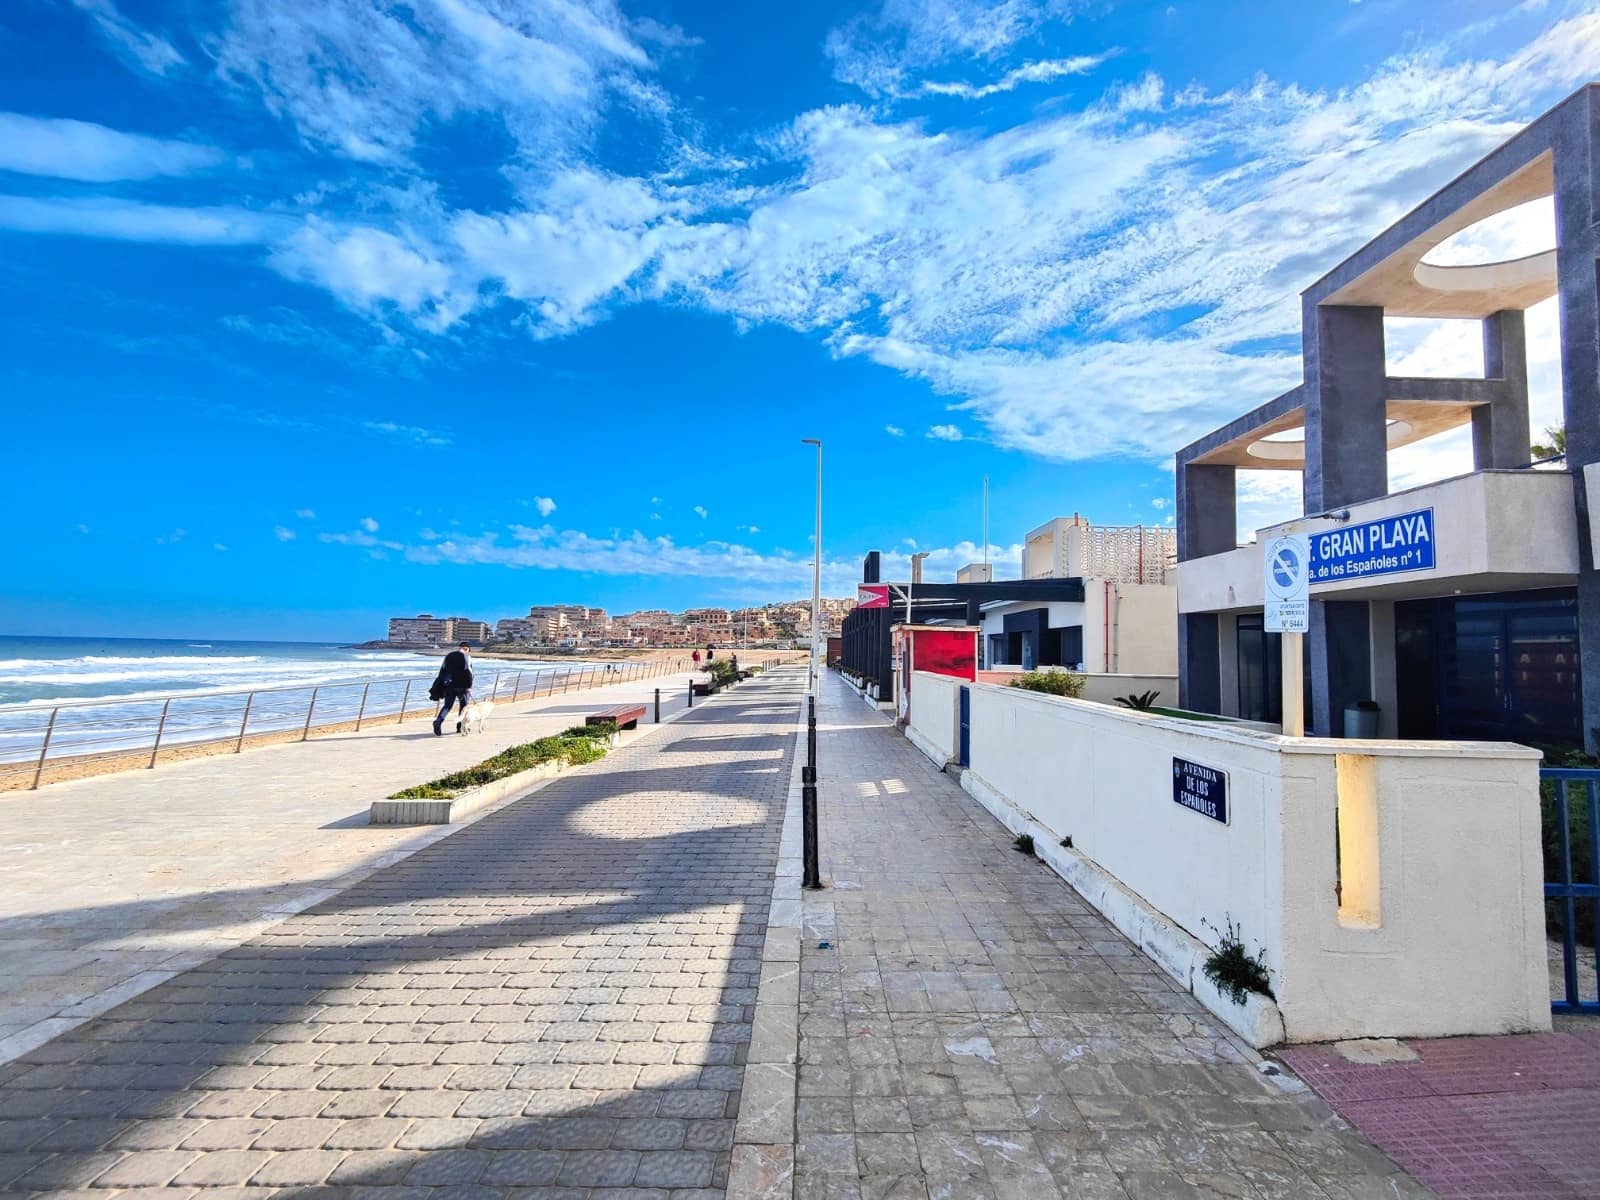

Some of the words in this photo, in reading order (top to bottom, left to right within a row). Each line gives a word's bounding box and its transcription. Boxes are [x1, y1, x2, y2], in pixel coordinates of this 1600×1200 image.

[1319, 527, 1365, 561] GRAN
[1369, 515, 1430, 552] PLAYA
[1318, 564, 1329, 578] de
[1331, 563, 1344, 576] los
[1346, 555, 1398, 575] Españoles
[1415, 549, 1422, 564] 1
[1183, 762, 1217, 783] AVENIDA
[1186, 776, 1194, 791] DE
[1196, 779, 1209, 797] LOS
[1180, 790, 1217, 818] ESPAÑOLES
